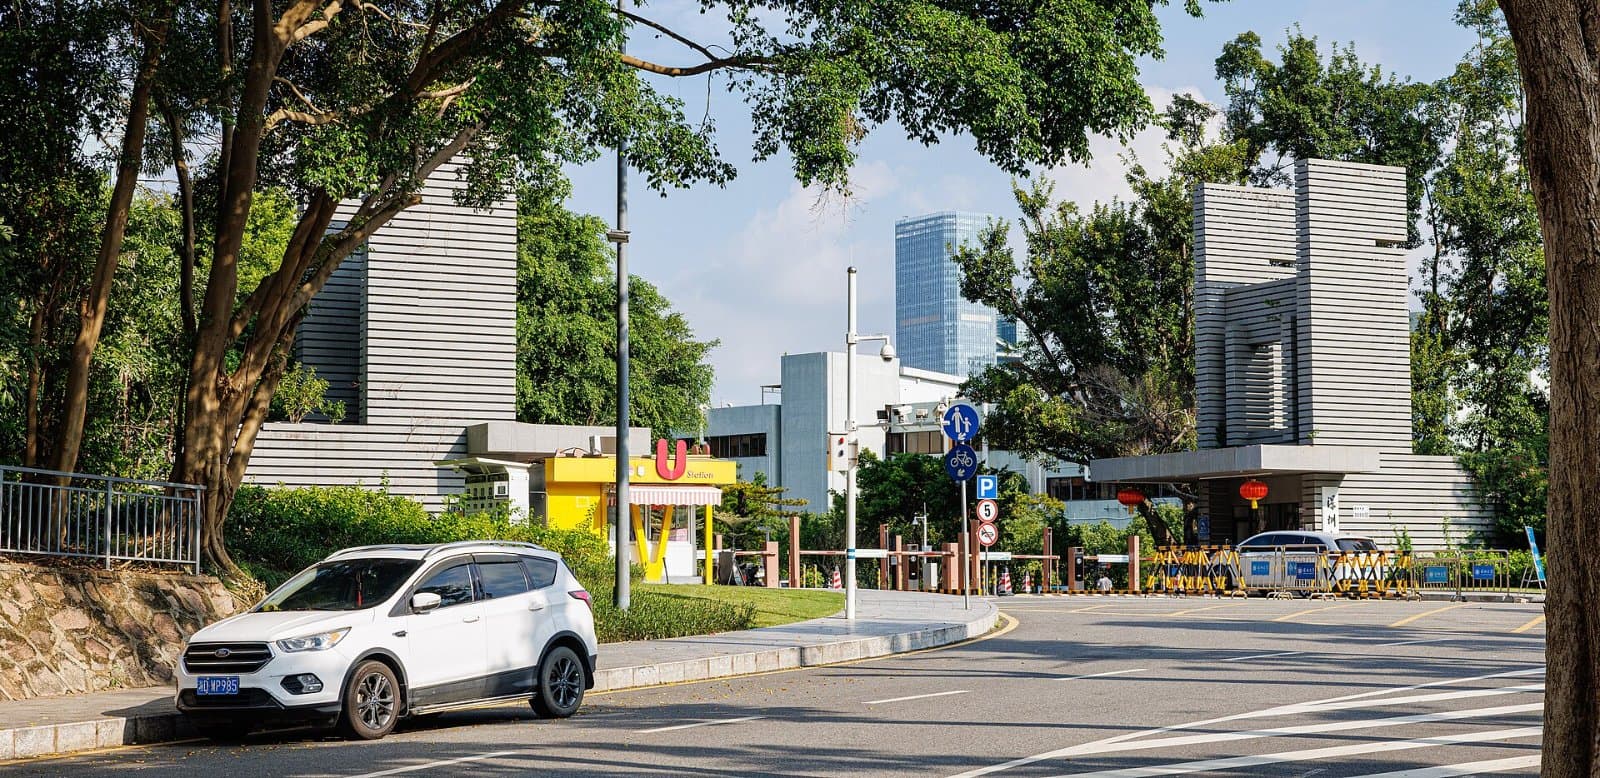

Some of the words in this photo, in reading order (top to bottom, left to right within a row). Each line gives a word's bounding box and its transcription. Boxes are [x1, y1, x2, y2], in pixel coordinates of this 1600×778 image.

[656, 438, 687, 480] U
[980, 478, 993, 496] P
[984, 504, 991, 517] 5
